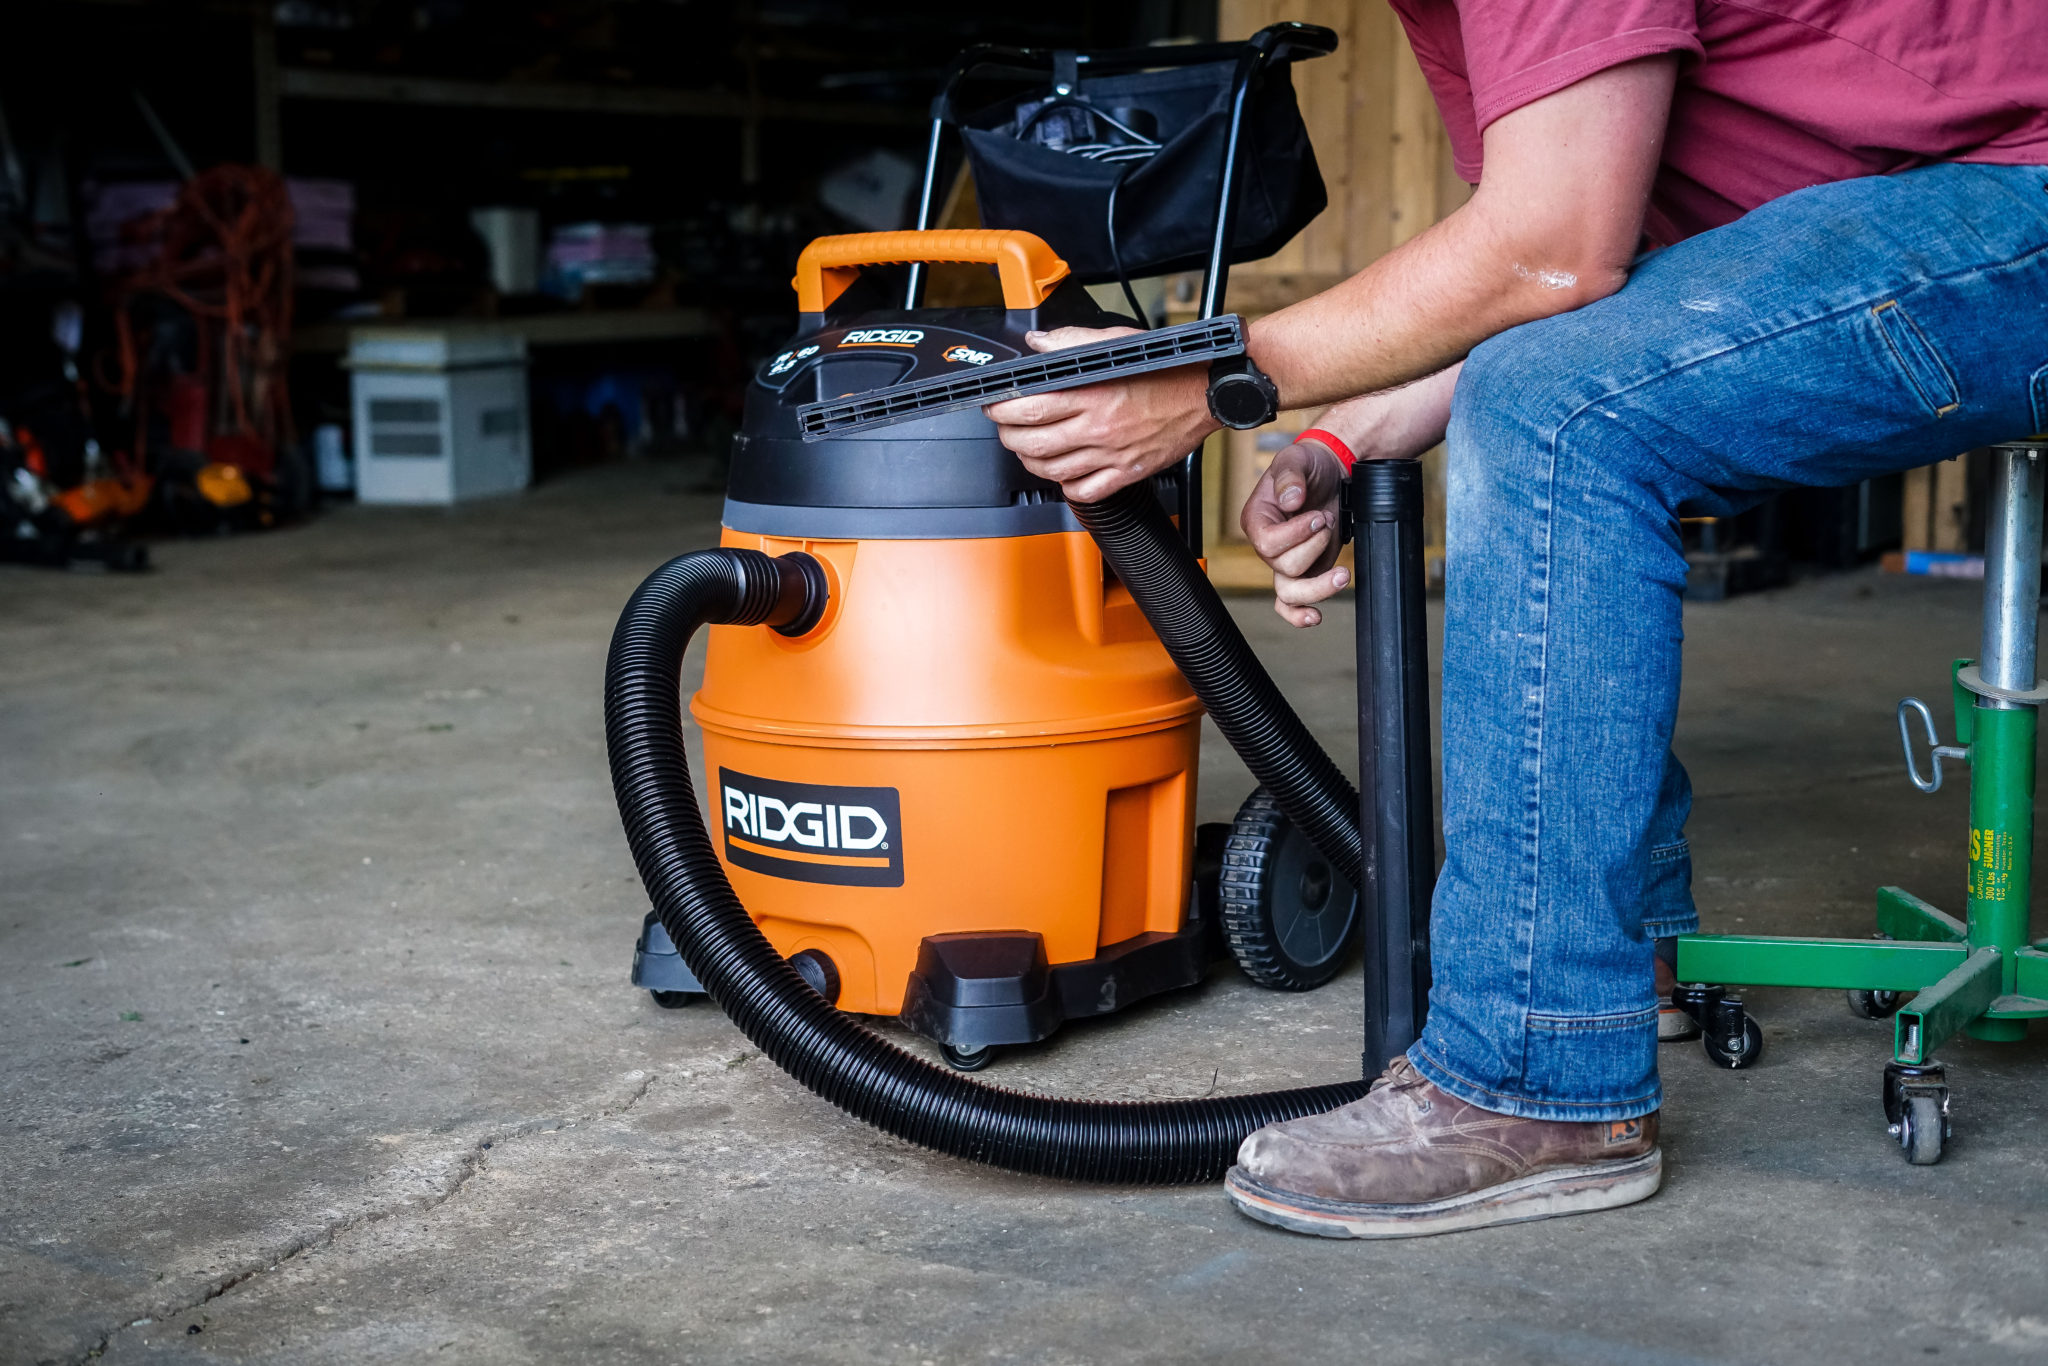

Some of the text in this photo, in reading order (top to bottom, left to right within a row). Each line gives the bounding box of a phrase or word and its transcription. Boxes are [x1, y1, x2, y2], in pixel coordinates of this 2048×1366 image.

[841, 330, 924, 344] RIDGID
[948, 348, 994, 366] SNR
[725, 785, 888, 850] RIDGID
[1983, 829, 1994, 869] SUMNER
[1986, 886, 1995, 901] 300
